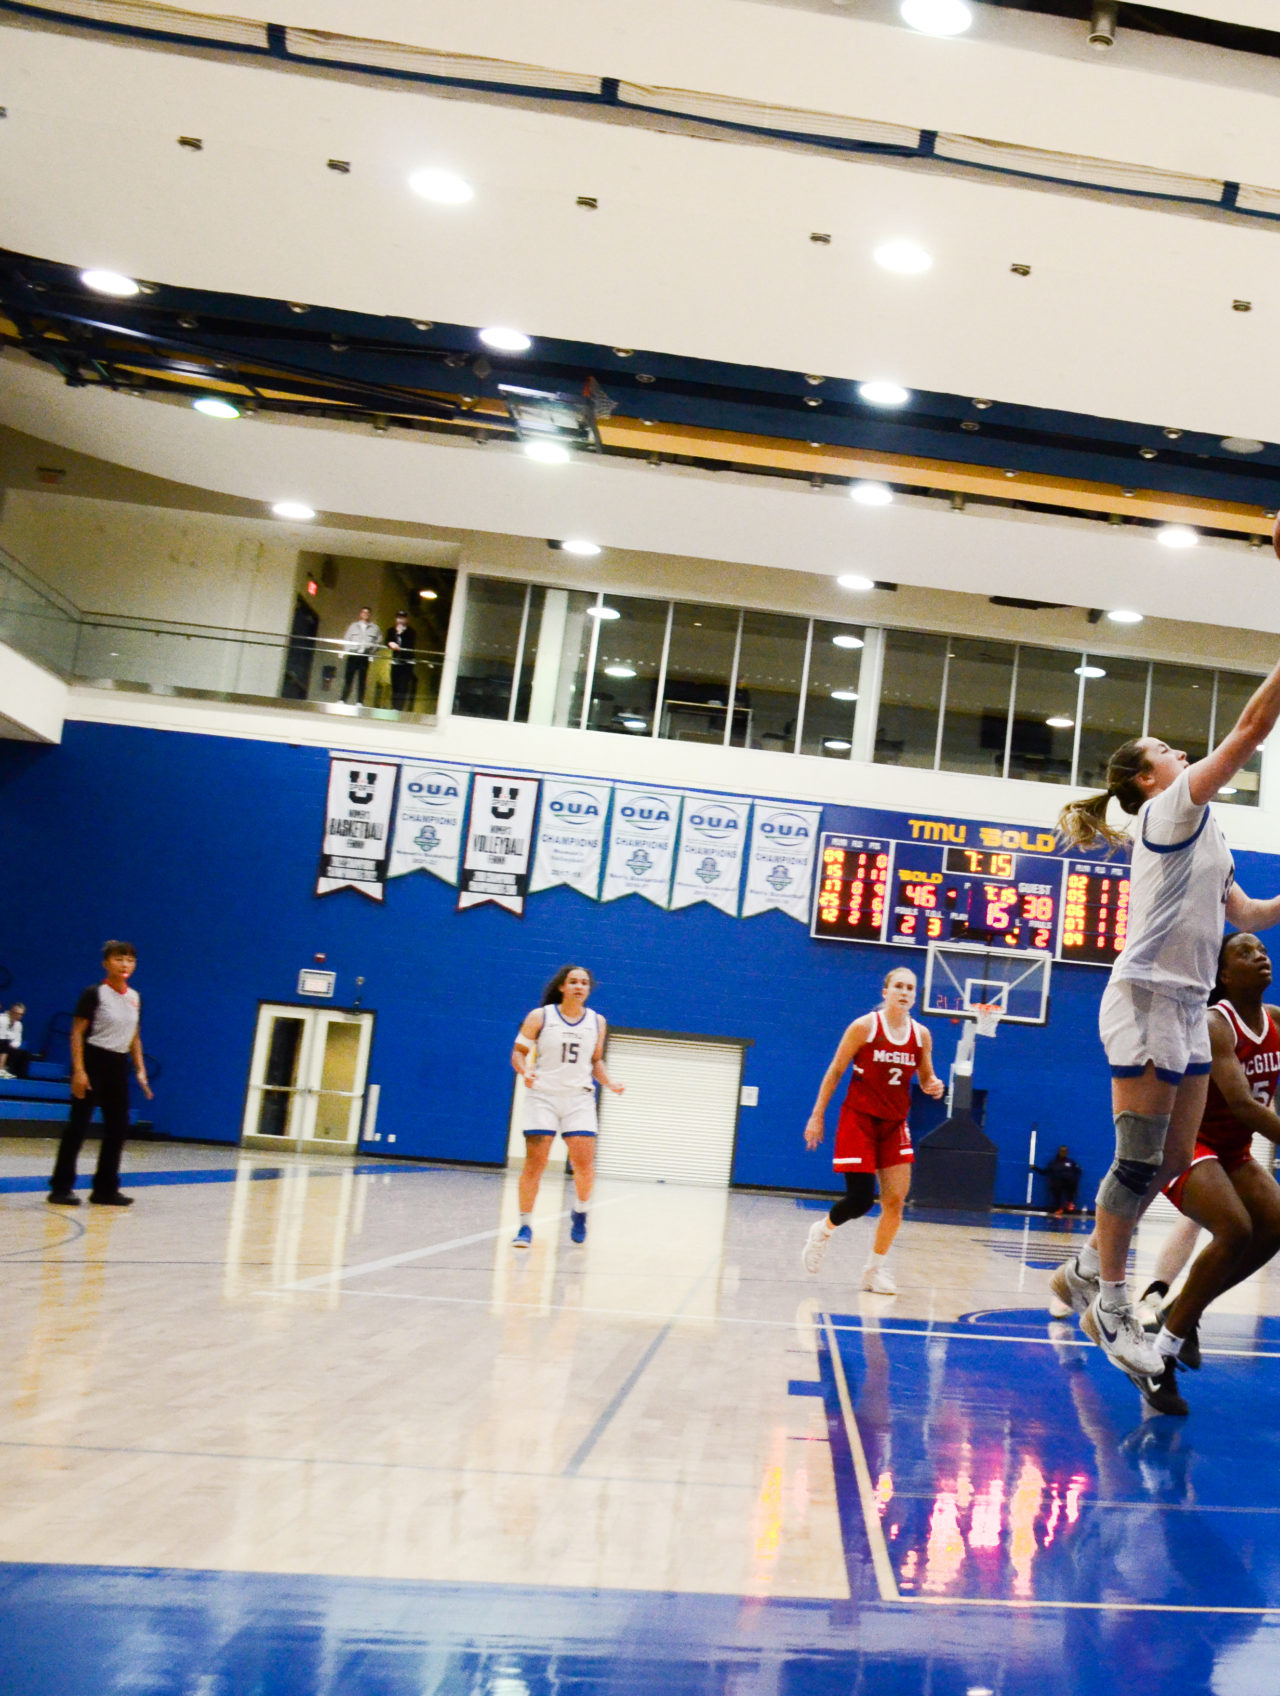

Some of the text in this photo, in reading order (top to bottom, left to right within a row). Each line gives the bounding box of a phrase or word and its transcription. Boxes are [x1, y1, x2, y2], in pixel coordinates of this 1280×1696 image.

[407, 782, 459, 797] OUA
[549, 801, 599, 816] OUA
[620, 806, 670, 821] OUA
[402, 812, 456, 826] CHAMPIONS
[689, 814, 739, 830] OUA
[328, 817, 384, 841] BASKETBALL
[760, 822, 809, 837] OUA
[908, 820, 1056, 852] TMU BOLD
[473, 834, 525, 856] VOLLEYBALL
[542, 834, 599, 848] CHAMPIONS
[615, 836, 669, 850] CHAMPIONS
[684, 844, 738, 858] CHAMPIONS
[755, 853, 809, 866] CHAMPIONS
[858, 853, 866, 866] 1
[876, 854, 888, 868] 0
[964, 851, 1012, 877] 7:15
[826, 864, 843, 877] 15
[857, 867, 865, 879] 1
[898, 869, 943, 884] BOLD
[819, 892, 840, 907] 25
[850, 895, 862, 910] 2
[872, 897, 884, 912] 6
[905, 884, 937, 908] 46
[986, 902, 1010, 929] 15
[1022, 894, 1053, 921] 38
[848, 911, 861, 926] 2
[871, 912, 883, 928] 3
[900, 915, 916, 934] 2
[927, 917, 942, 937] 3
[1034, 928, 1050, 948] 2
[562, 1042, 579, 1064] 15
[873, 1050, 917, 1067] McGILL
[888, 1067, 903, 1086] 2
